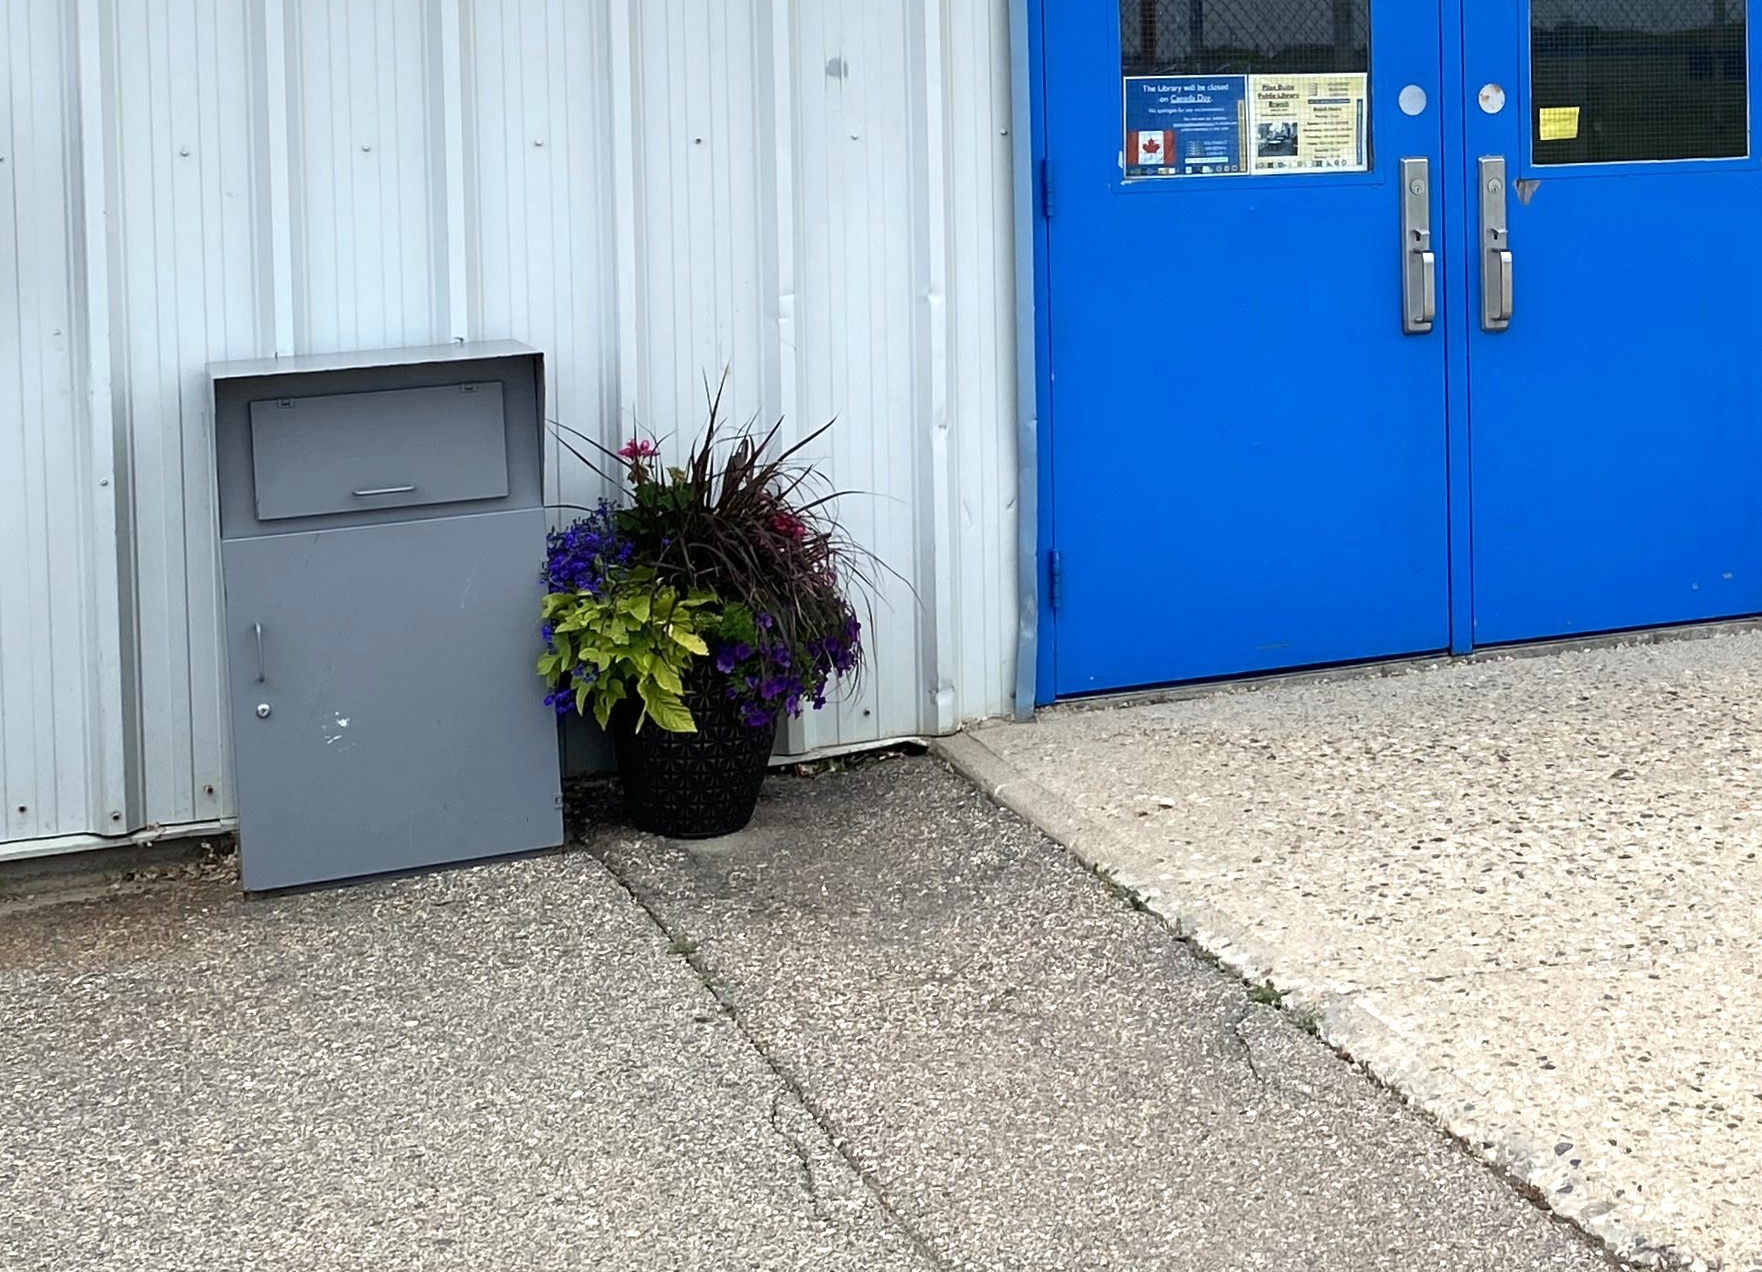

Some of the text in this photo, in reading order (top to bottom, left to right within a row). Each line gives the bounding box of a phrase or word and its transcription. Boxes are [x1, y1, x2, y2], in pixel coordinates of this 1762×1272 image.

[1142, 83, 1230, 94] The Library will be closed
